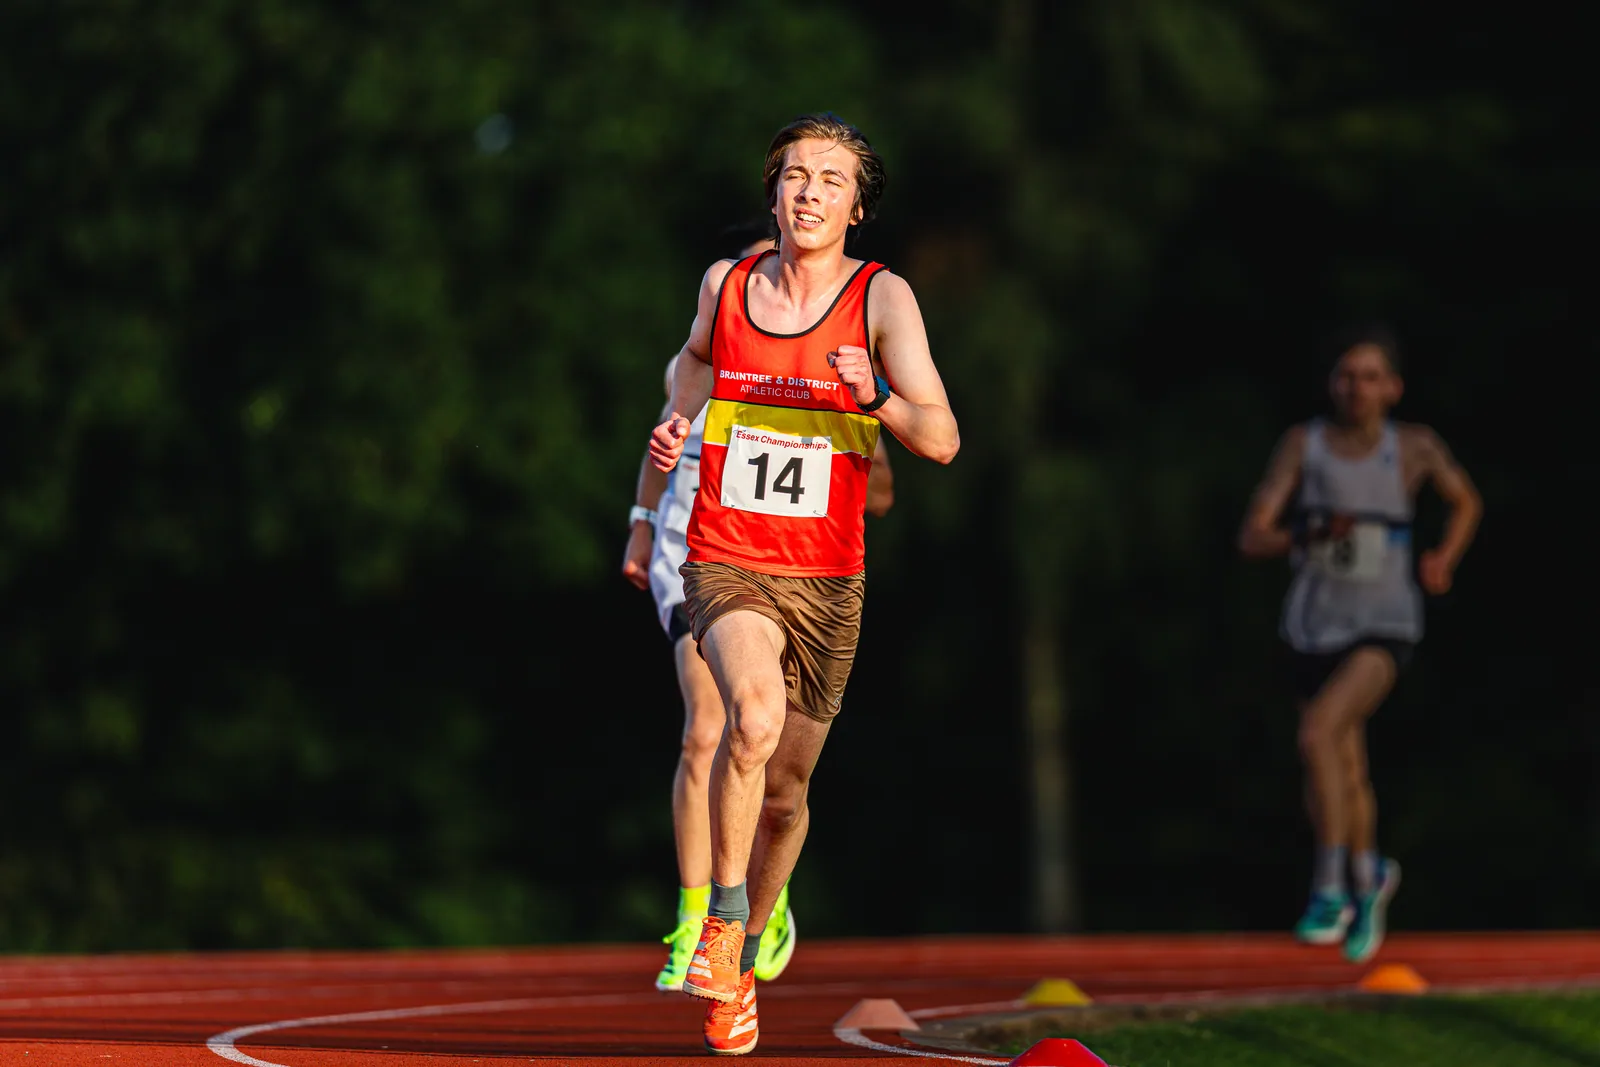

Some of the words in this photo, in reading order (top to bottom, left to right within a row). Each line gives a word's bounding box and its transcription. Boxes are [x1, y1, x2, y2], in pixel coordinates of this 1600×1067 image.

[720, 370, 772, 384] BRAINTREE
[776, 376, 784, 385] &
[788, 376, 839, 391] DISTRICT
[740, 384, 782, 397] ATHLETIC
[784, 389, 810, 399] CLUB
[736, 430, 759, 442] Essex
[760, 435, 828, 450] Championships
[748, 452, 805, 504] 14
